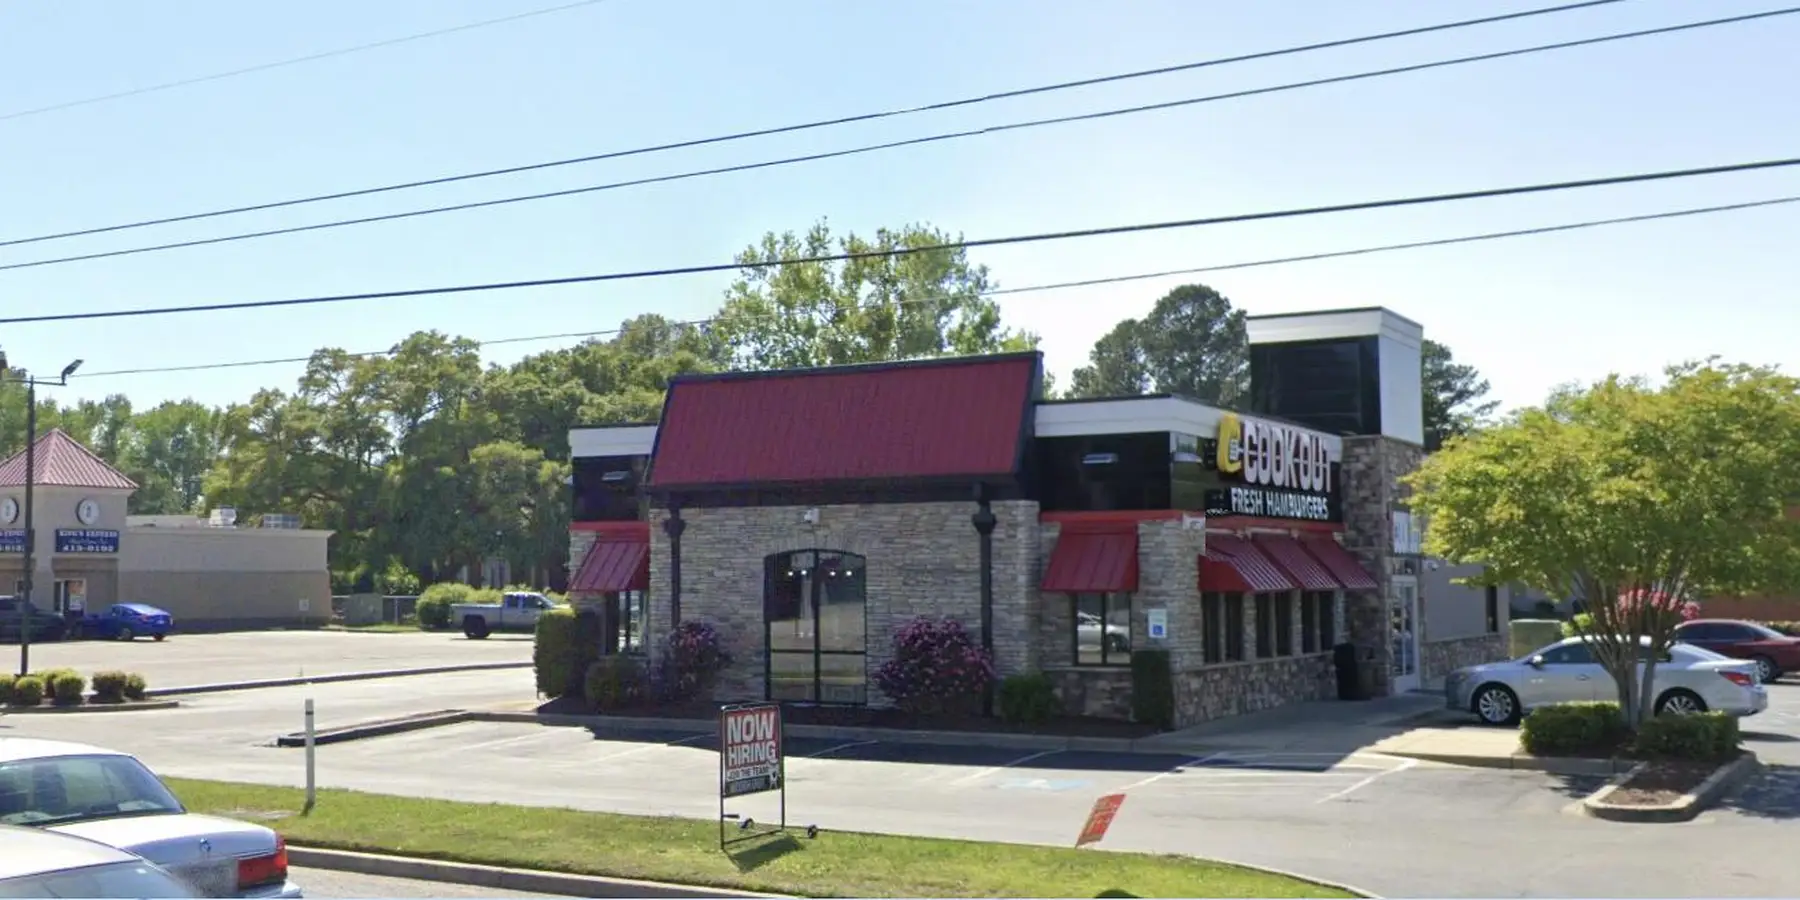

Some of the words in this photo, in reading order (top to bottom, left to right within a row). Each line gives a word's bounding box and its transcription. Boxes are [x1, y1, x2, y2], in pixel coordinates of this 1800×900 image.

[1231, 487, 1263, 515] FRESH
[1266, 491, 1329, 520] HAMBURGERS
[727, 712, 775, 744] NOW
[728, 741, 777, 767] HIRING
